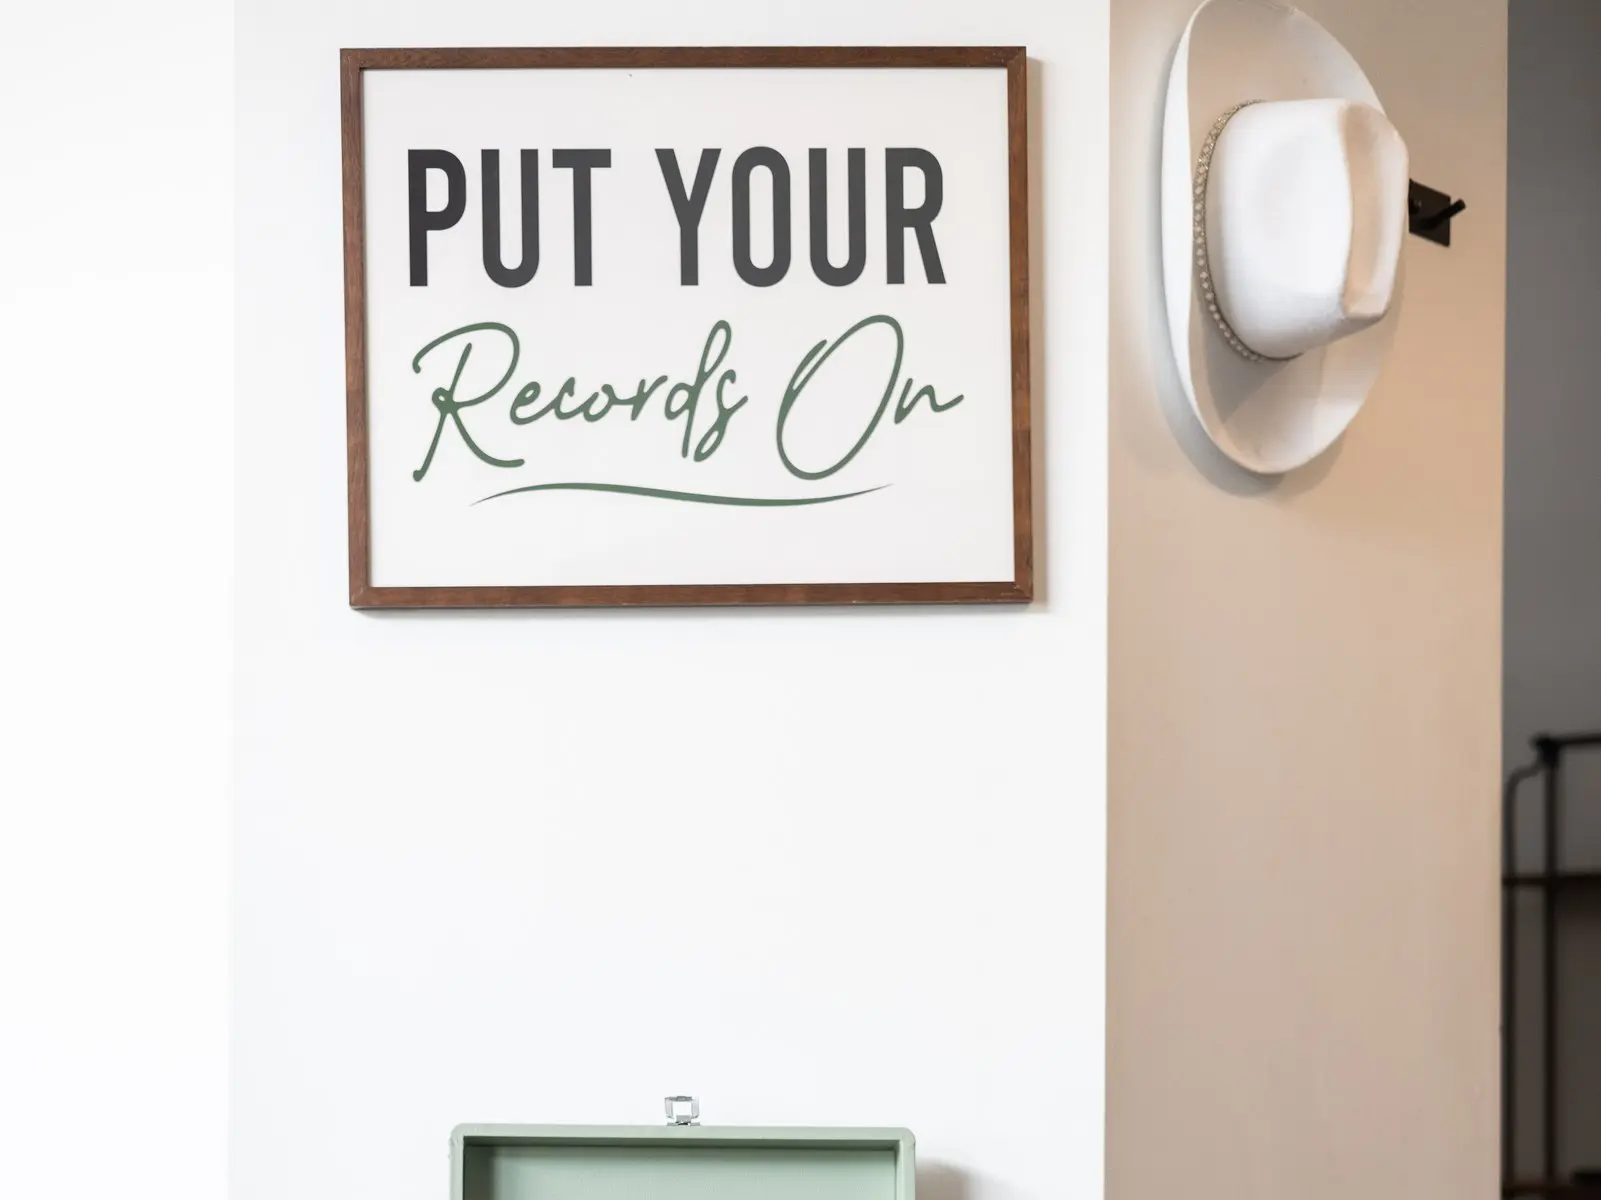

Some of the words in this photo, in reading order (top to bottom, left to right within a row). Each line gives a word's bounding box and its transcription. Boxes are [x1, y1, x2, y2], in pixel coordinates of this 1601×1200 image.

[408, 149, 612, 289] PUT
[655, 147, 947, 288] YOUR
[411, 321, 749, 482] Records
[776, 314, 965, 481] On
